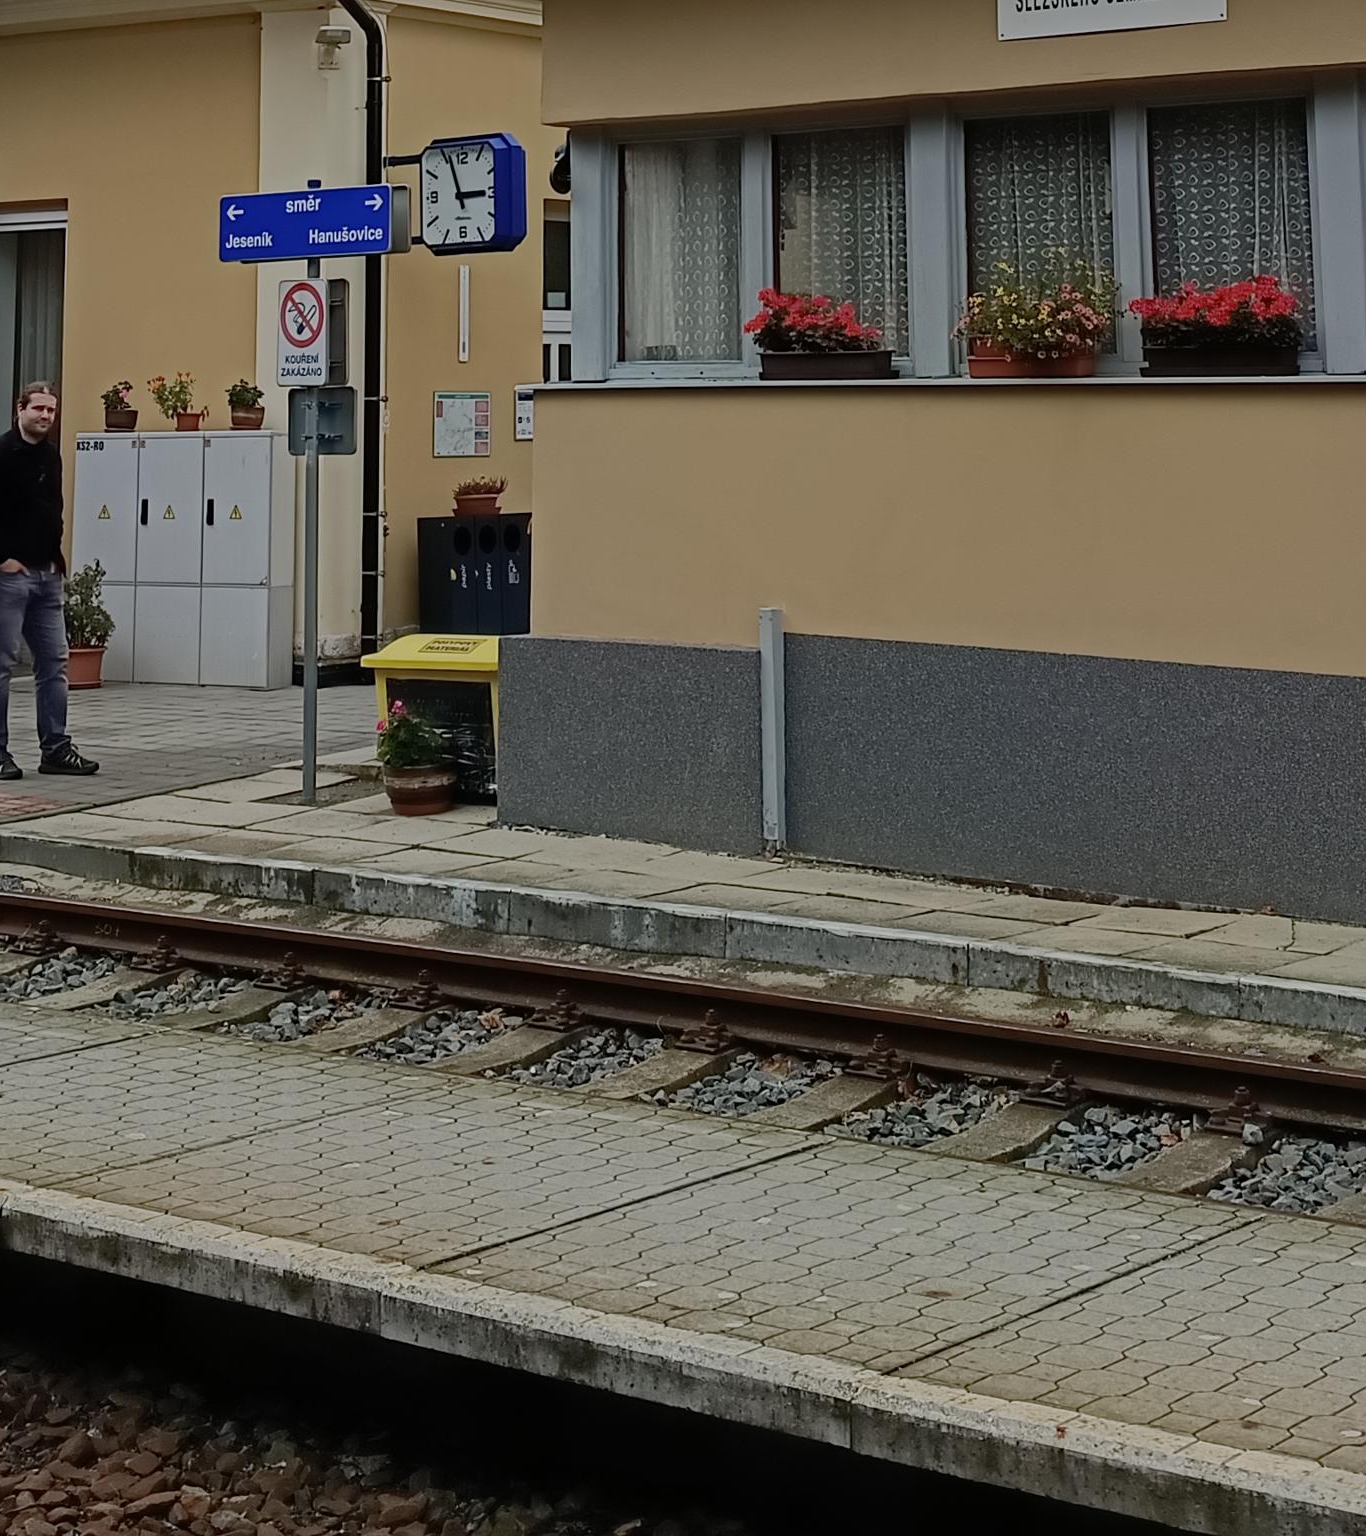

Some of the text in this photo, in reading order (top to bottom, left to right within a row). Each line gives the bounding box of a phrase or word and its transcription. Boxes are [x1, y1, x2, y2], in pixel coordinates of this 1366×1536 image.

[456, 152, 468, 165] 12
[285, 194, 322, 214] směr
[430, 191, 438, 204] 9
[225, 226, 383, 249] Jeseník Hanušovice
[459, 226, 467, 238] 6
[285, 353, 319, 364] KOUŘENÍ
[281, 366, 322, 376] ZAKÁZÁNO
